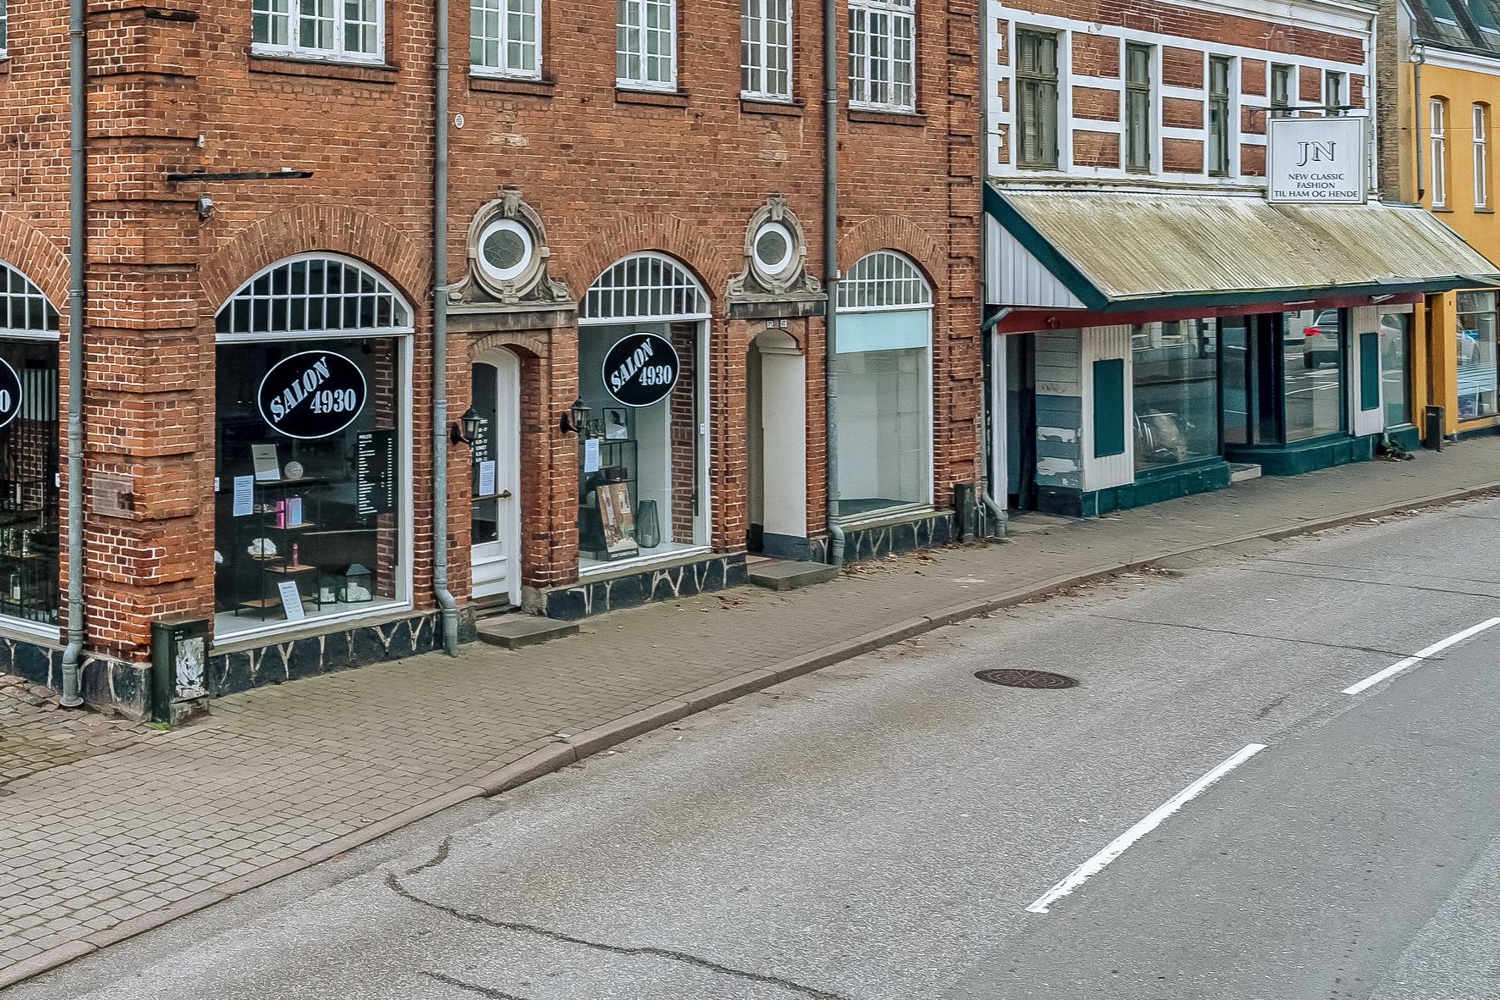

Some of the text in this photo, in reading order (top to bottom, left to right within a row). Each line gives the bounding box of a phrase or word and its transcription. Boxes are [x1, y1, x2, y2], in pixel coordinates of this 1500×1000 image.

[1296, 141, 1337, 167] JN
[1288, 190, 1310, 198] HAM
[1311, 190, 1327, 198] OG
[1328, 190, 1358, 198] HENDE
[611, 338, 654, 393] SALON
[639, 365, 673, 386] 4930
[270, 356, 330, 423] SALON
[310, 388, 356, 414] 4930
